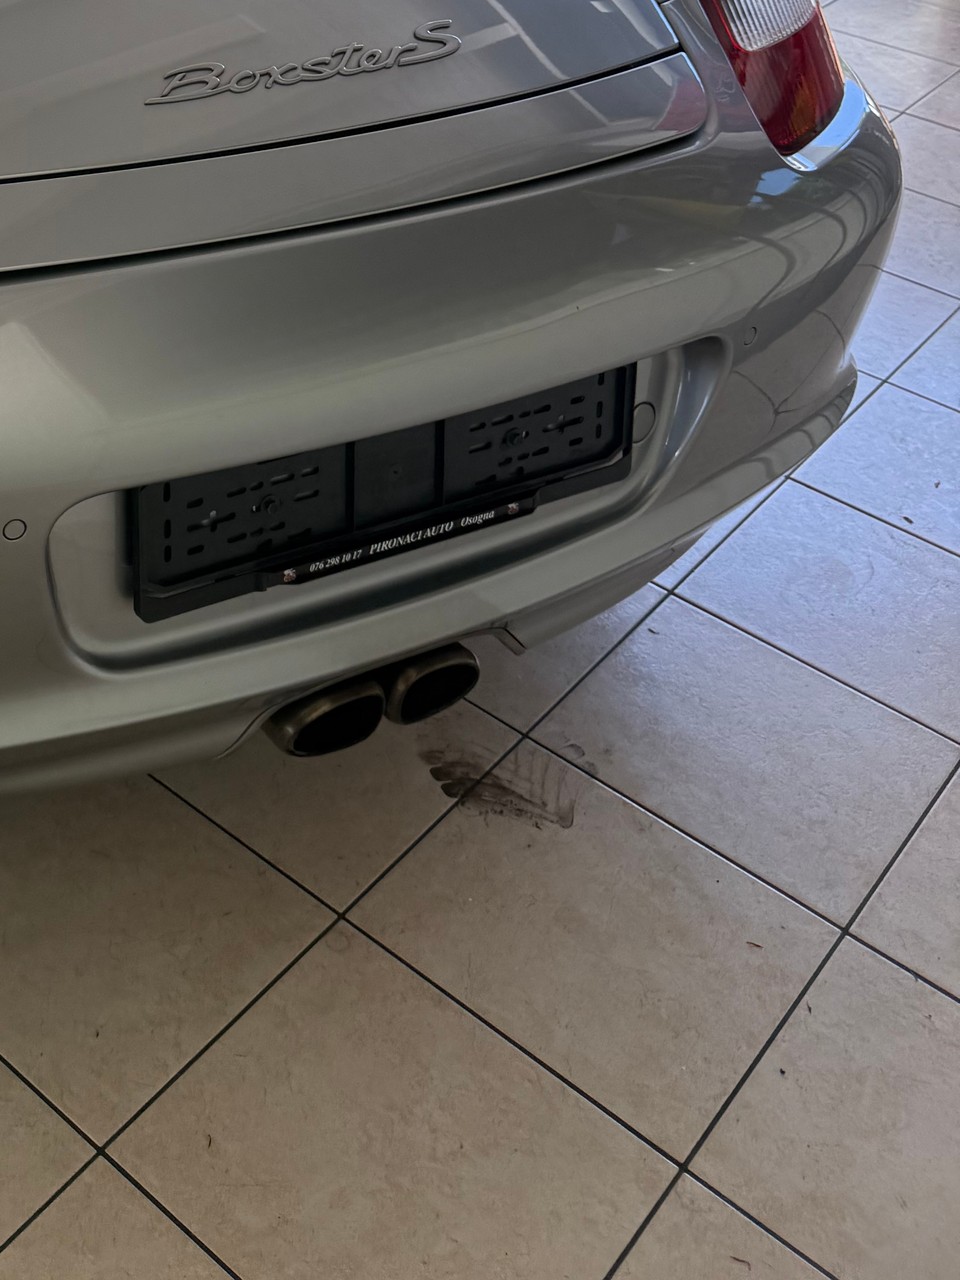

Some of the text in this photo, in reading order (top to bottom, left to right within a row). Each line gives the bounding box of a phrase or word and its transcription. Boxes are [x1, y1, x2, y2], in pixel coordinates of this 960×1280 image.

[143, 19, 462, 106] Boxster S
[309, 510, 495, 572] 076 298 10 17 PIRONACI AUTO Osogna
